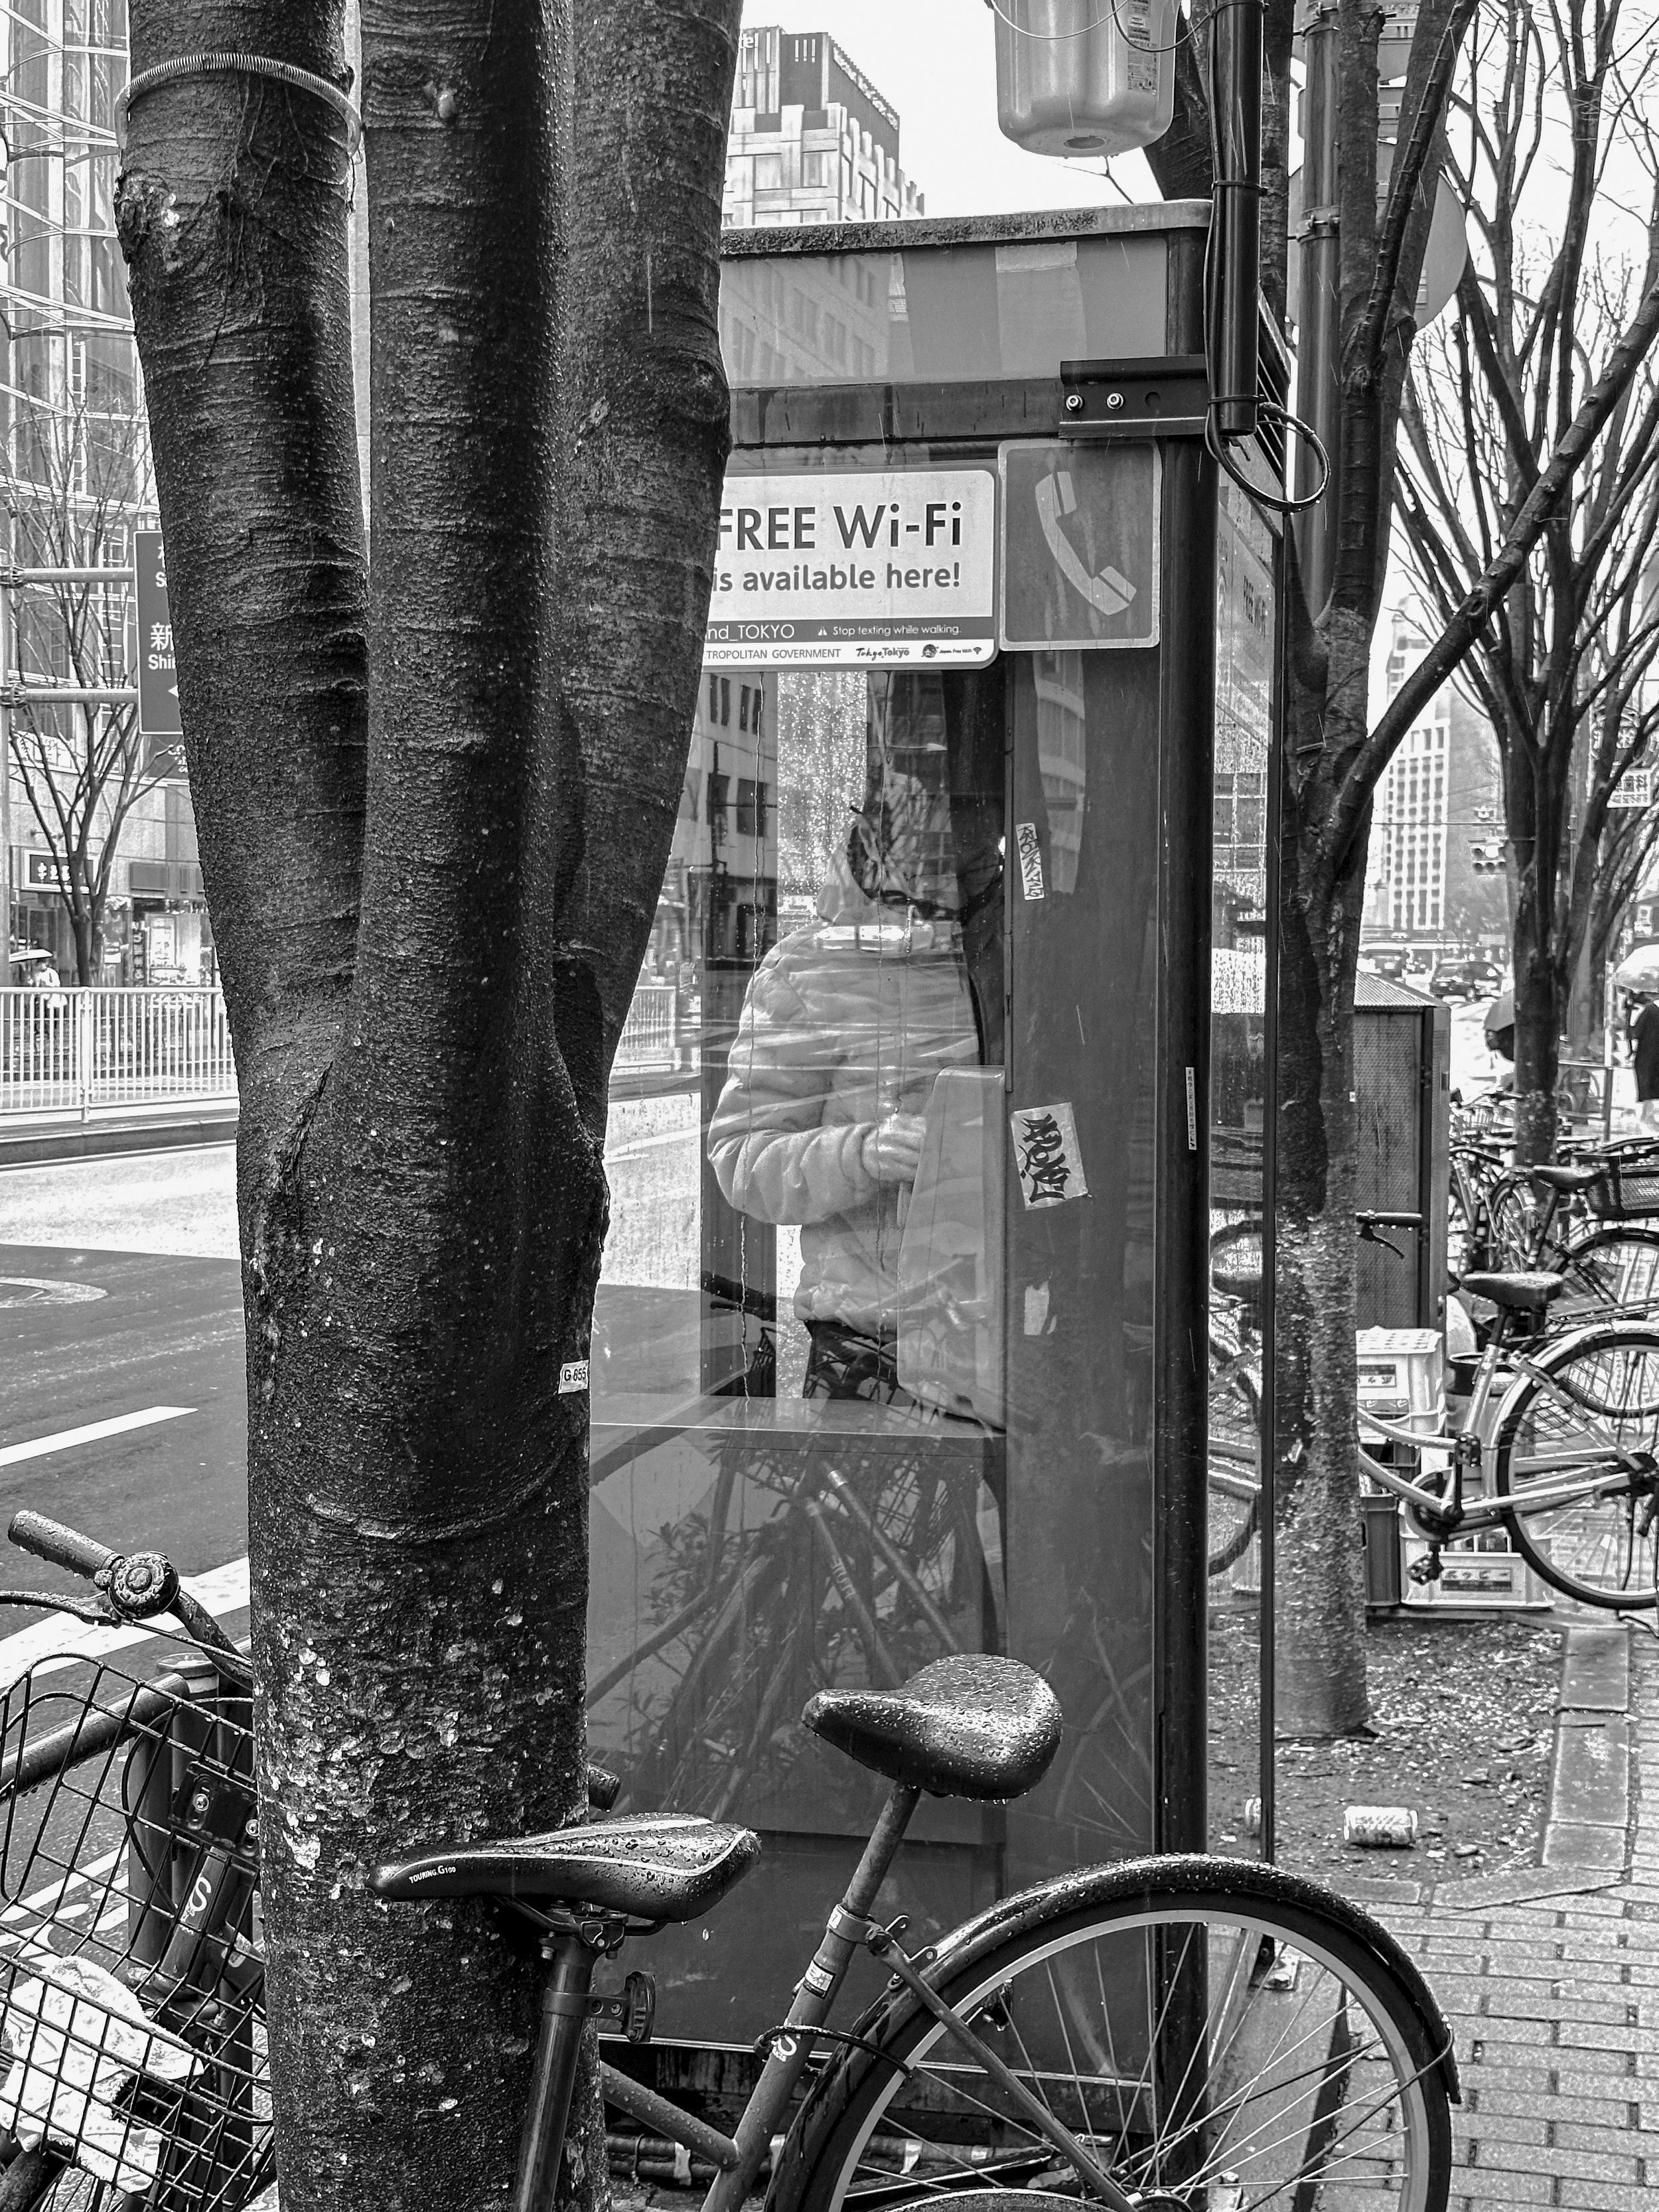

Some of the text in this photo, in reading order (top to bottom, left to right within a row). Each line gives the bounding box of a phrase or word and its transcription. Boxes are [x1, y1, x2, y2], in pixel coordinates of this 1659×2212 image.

[717, 502, 962, 550] FREE Wi-Fi
[713, 562, 960, 591] is available here!
[705, 624, 795, 641] nd_TOKYO
[833, 626, 855, 636] Stop
[858, 626, 891, 636] texting
[894, 625, 918, 634] while
[706, 649, 841, 659] TROPOLITAN GOVERNMENT
[408, 1865, 457, 1884] TOURING G100
